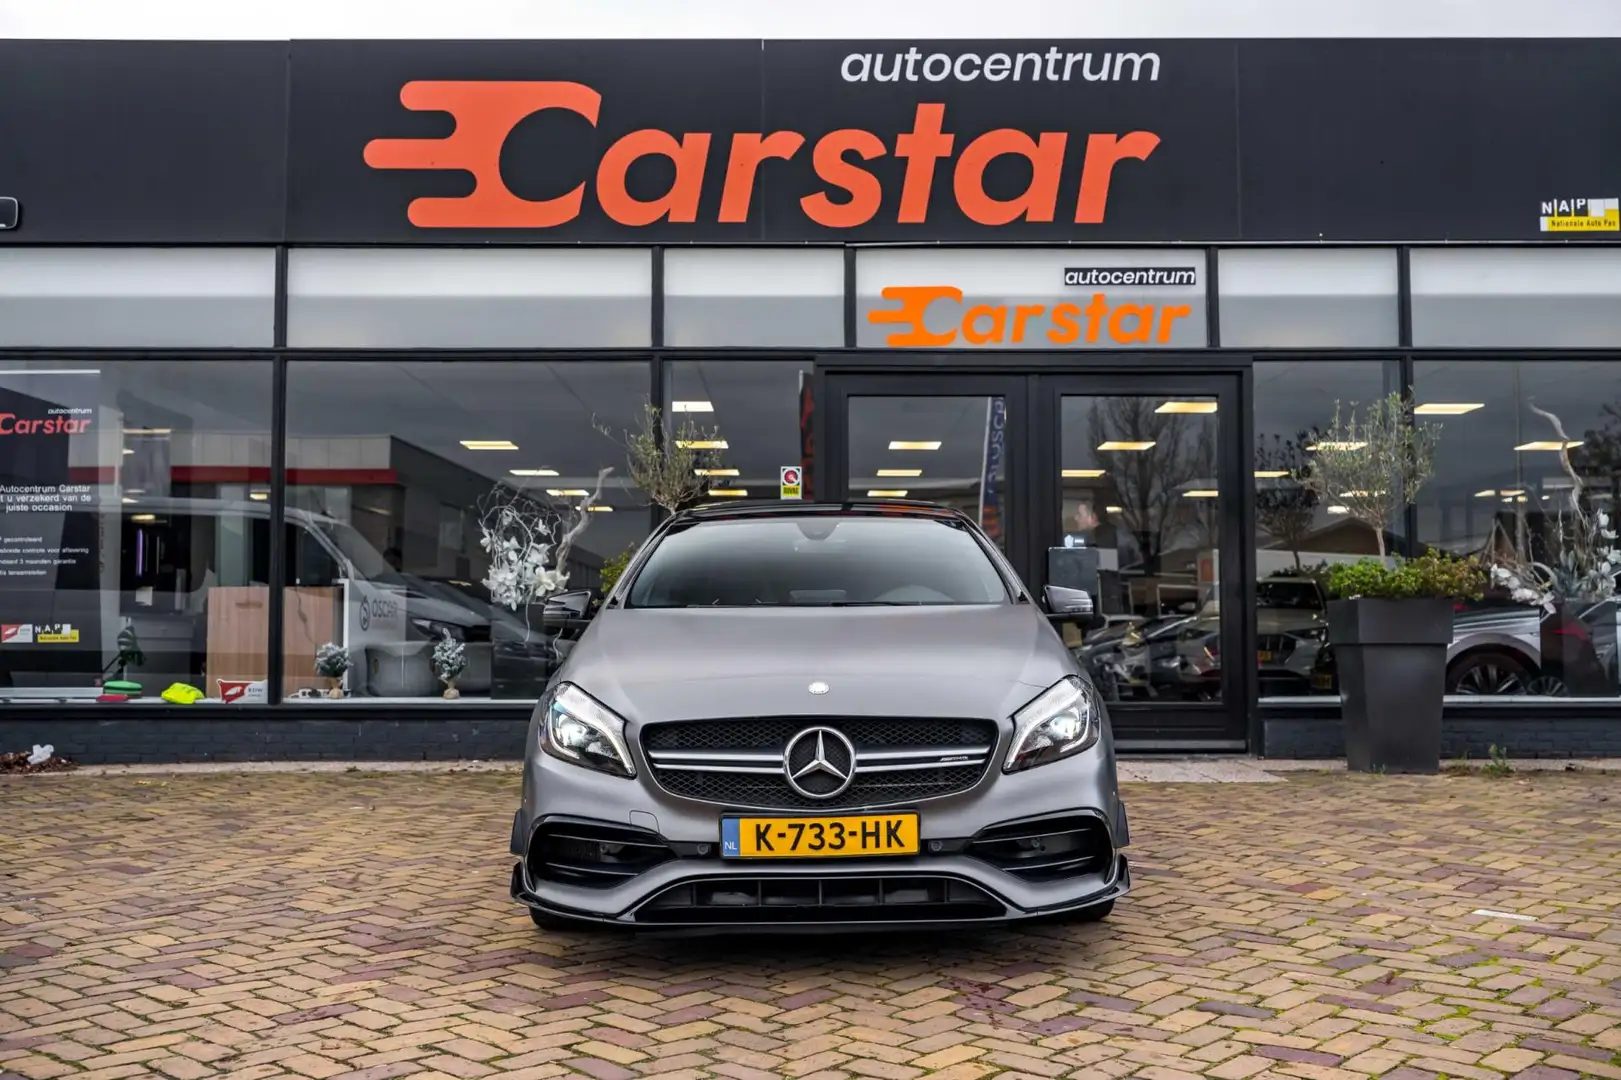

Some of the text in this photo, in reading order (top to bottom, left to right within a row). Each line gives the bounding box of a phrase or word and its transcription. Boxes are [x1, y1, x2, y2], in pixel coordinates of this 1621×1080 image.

[841, 46, 1160, 83] autocentrum
[364, 81, 1159, 227] Carstar
[1065, 269, 1196, 286] autocentrum
[868, 286, 1191, 347] Carstar
[0, 413, 92, 434] Carstar
[0, 484, 91, 493] Autocentrum Carstar
[16, 494, 60, 502] verzekerd
[80, 494, 92, 502] de
[6, 503, 73, 513] juiste occasion
[755, 819, 905, 852] K-733-HK
[724, 841, 738, 850] NL
